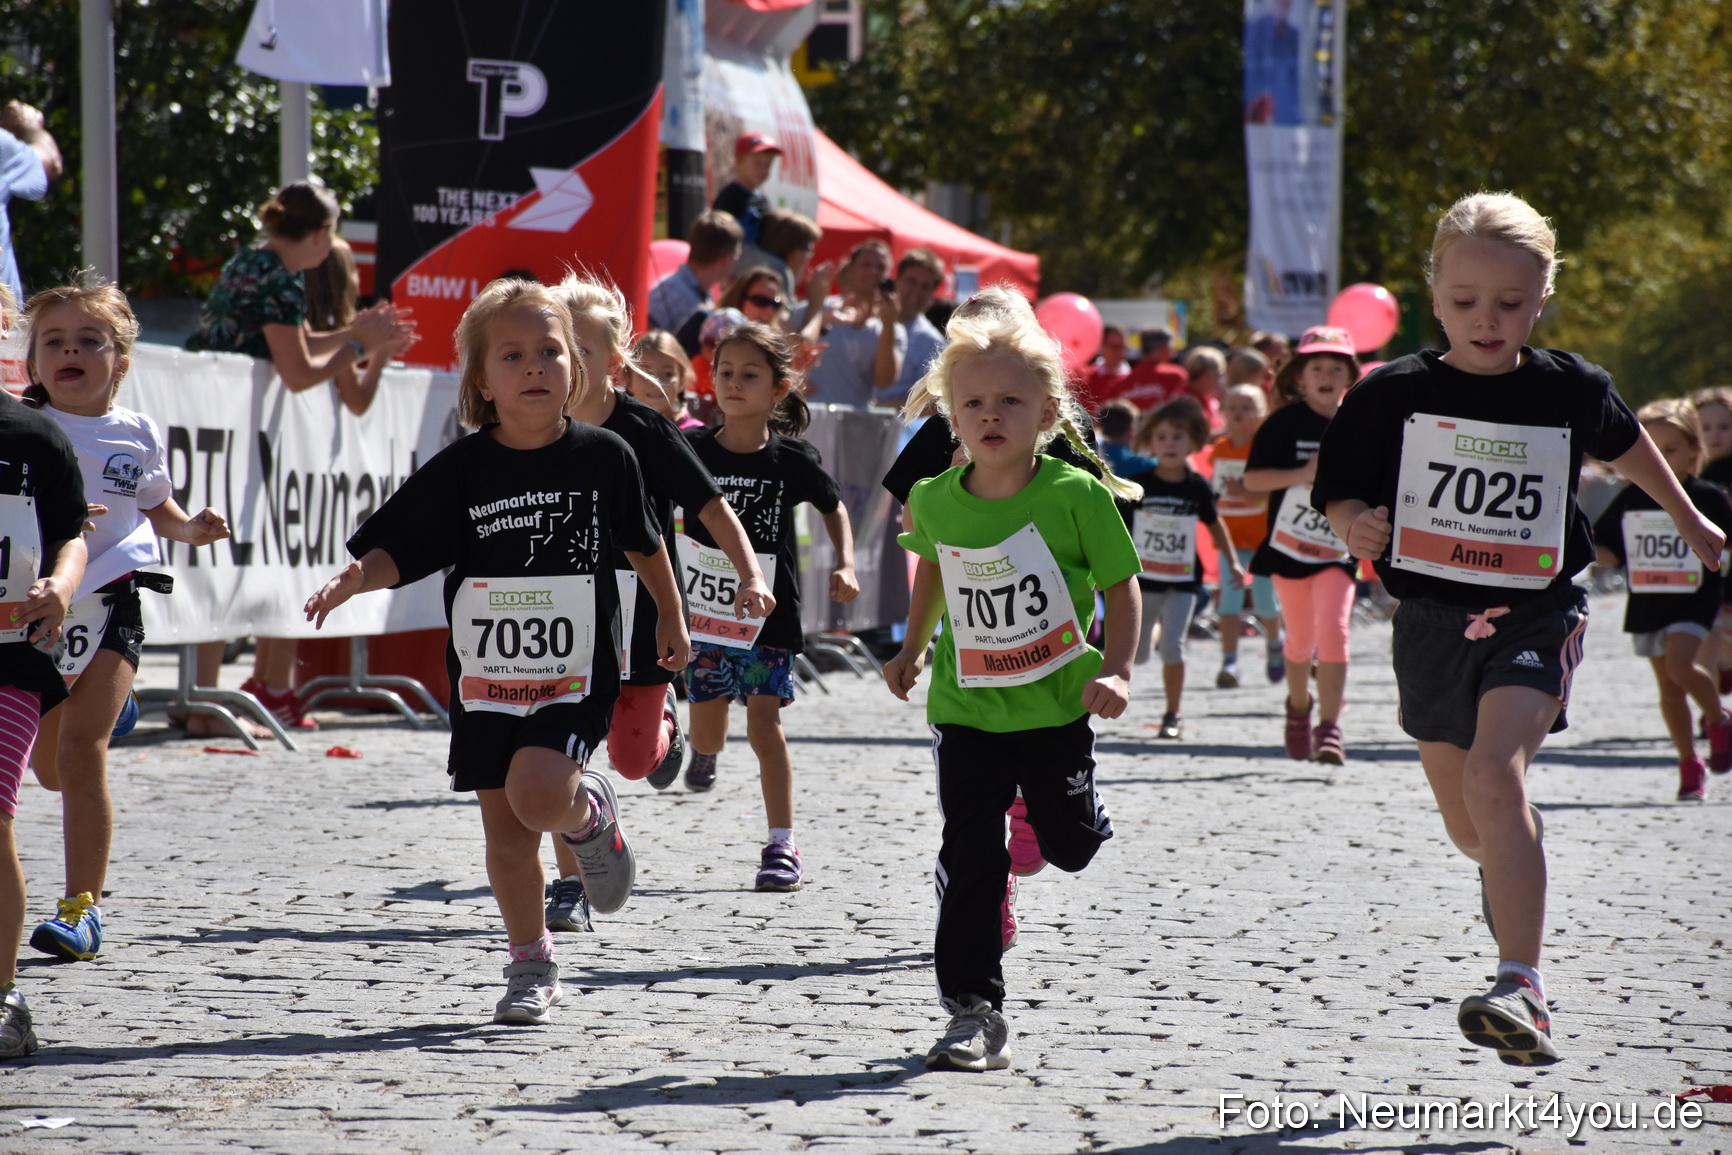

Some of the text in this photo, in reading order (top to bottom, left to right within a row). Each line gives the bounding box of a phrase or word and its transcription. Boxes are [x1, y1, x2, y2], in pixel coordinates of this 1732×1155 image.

[437, 187, 520, 210] THE NEXT
[412, 205, 497, 227] 100 YEARS
[406, 275, 466, 300] BMW
[1455, 434, 1528, 459] BOCK
[158, 425, 254, 568] RTL
[1404, 495, 1416, 504] B1
[1427, 461, 1544, 522] 7025
[468, 491, 562, 521] Neumarkter
[771, 480, 785, 542] BAMBINI
[591, 490, 599, 564] BAMBIN
[1291, 504, 1338, 539] 734
[1431, 517, 1517, 538] PARTL Neumarkt
[1143, 530, 1187, 554] 7534
[1634, 533, 1689, 559] 7050
[962, 555, 1016, 577] BOCK
[1450, 543, 1503, 569] Anna
[489, 590, 554, 606] BOCK
[686, 565, 742, 606] 755
[688, 601, 708, 612] PARTL
[958, 574, 1049, 630] 7073
[953, 619, 962, 628] B1
[975, 626, 1038, 645] PARTL Neumarkt
[471, 617, 574, 660] 7030
[483, 665, 554, 675] PARTL Neumarkt
[983, 643, 1052, 673] Mathilda
[1511, 659, 1544, 668] adidas
[487, 683, 557, 702] Charlotte
